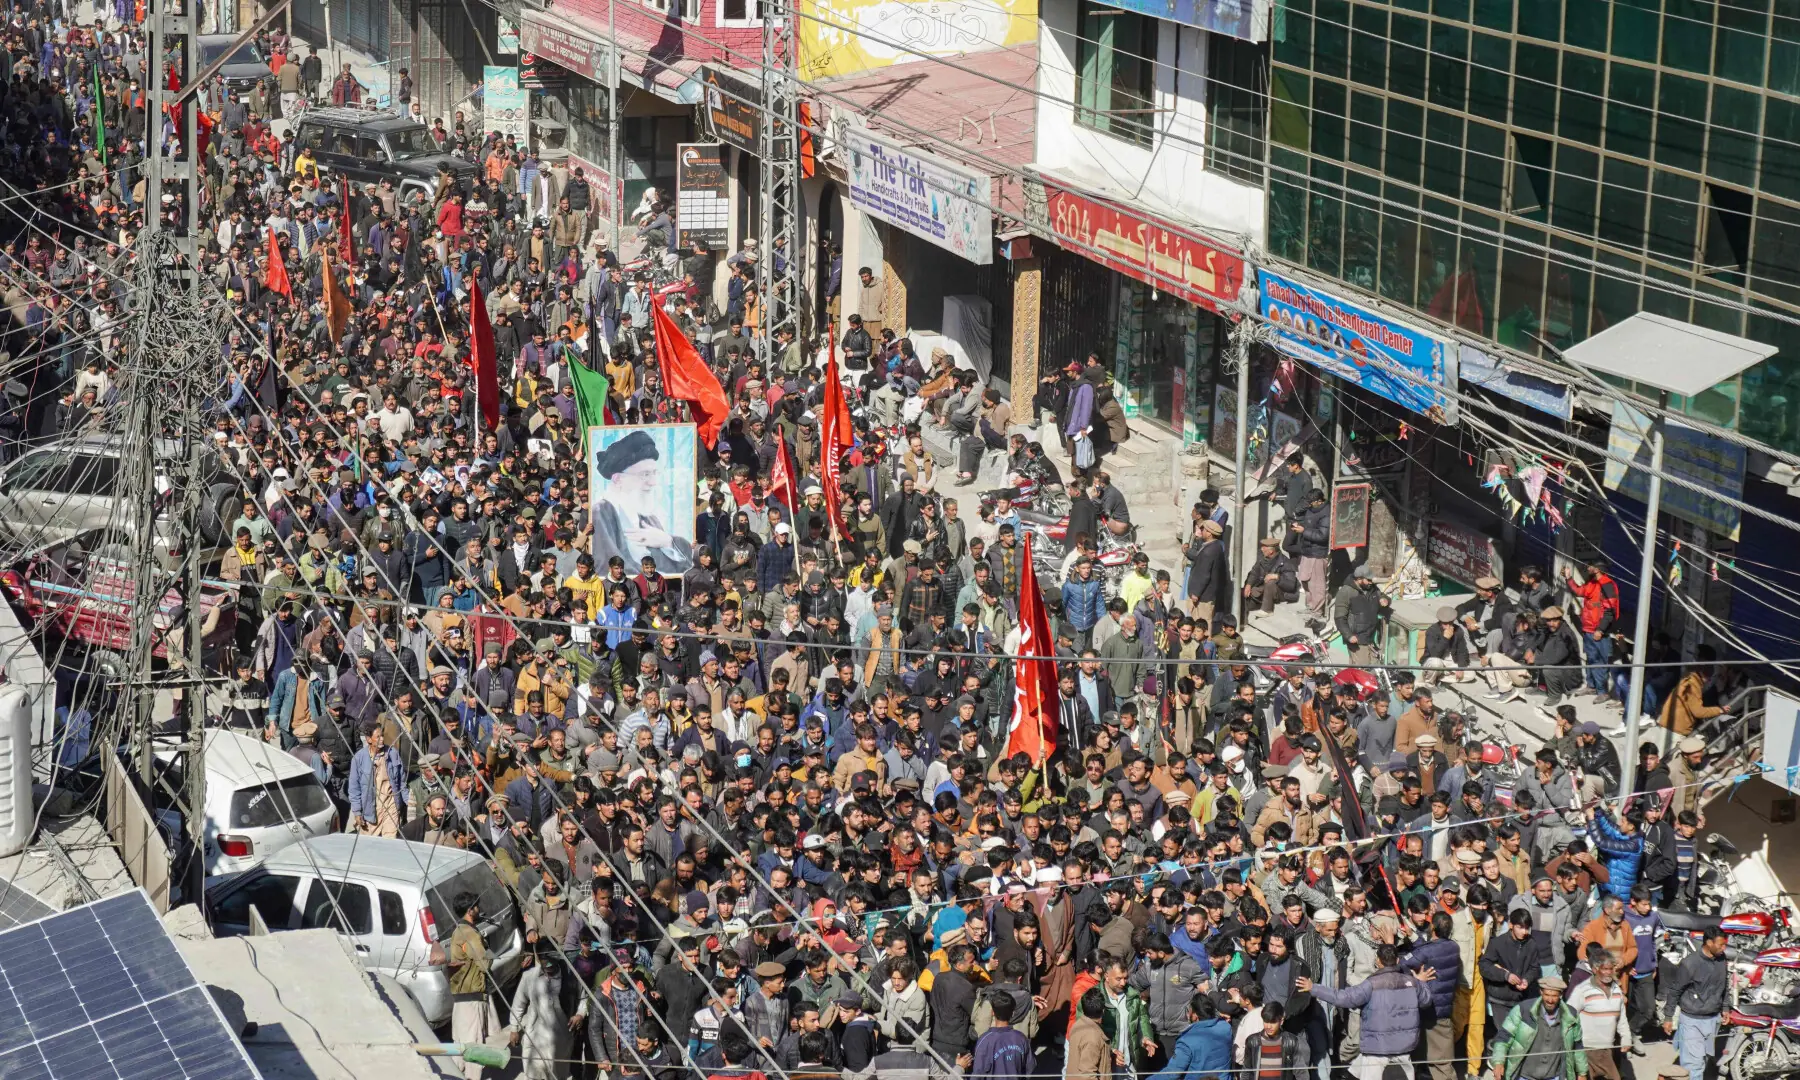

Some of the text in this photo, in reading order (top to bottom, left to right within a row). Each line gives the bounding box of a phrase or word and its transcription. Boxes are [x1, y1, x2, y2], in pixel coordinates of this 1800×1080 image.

[542, 38, 556, 52] HOTEL
[560, 46, 587, 65] RESTAURANT
[870, 143, 897, 185] The
[898, 154, 926, 198] Yak
[871, 179, 900, 201] Handicrafts
[904, 192, 914, 210] Dry
[914, 196, 930, 215] Fruits
[1056, 193, 1093, 247] 804
[1265, 278, 1414, 357] Fahad Dry Fruit & Handicraft Center
